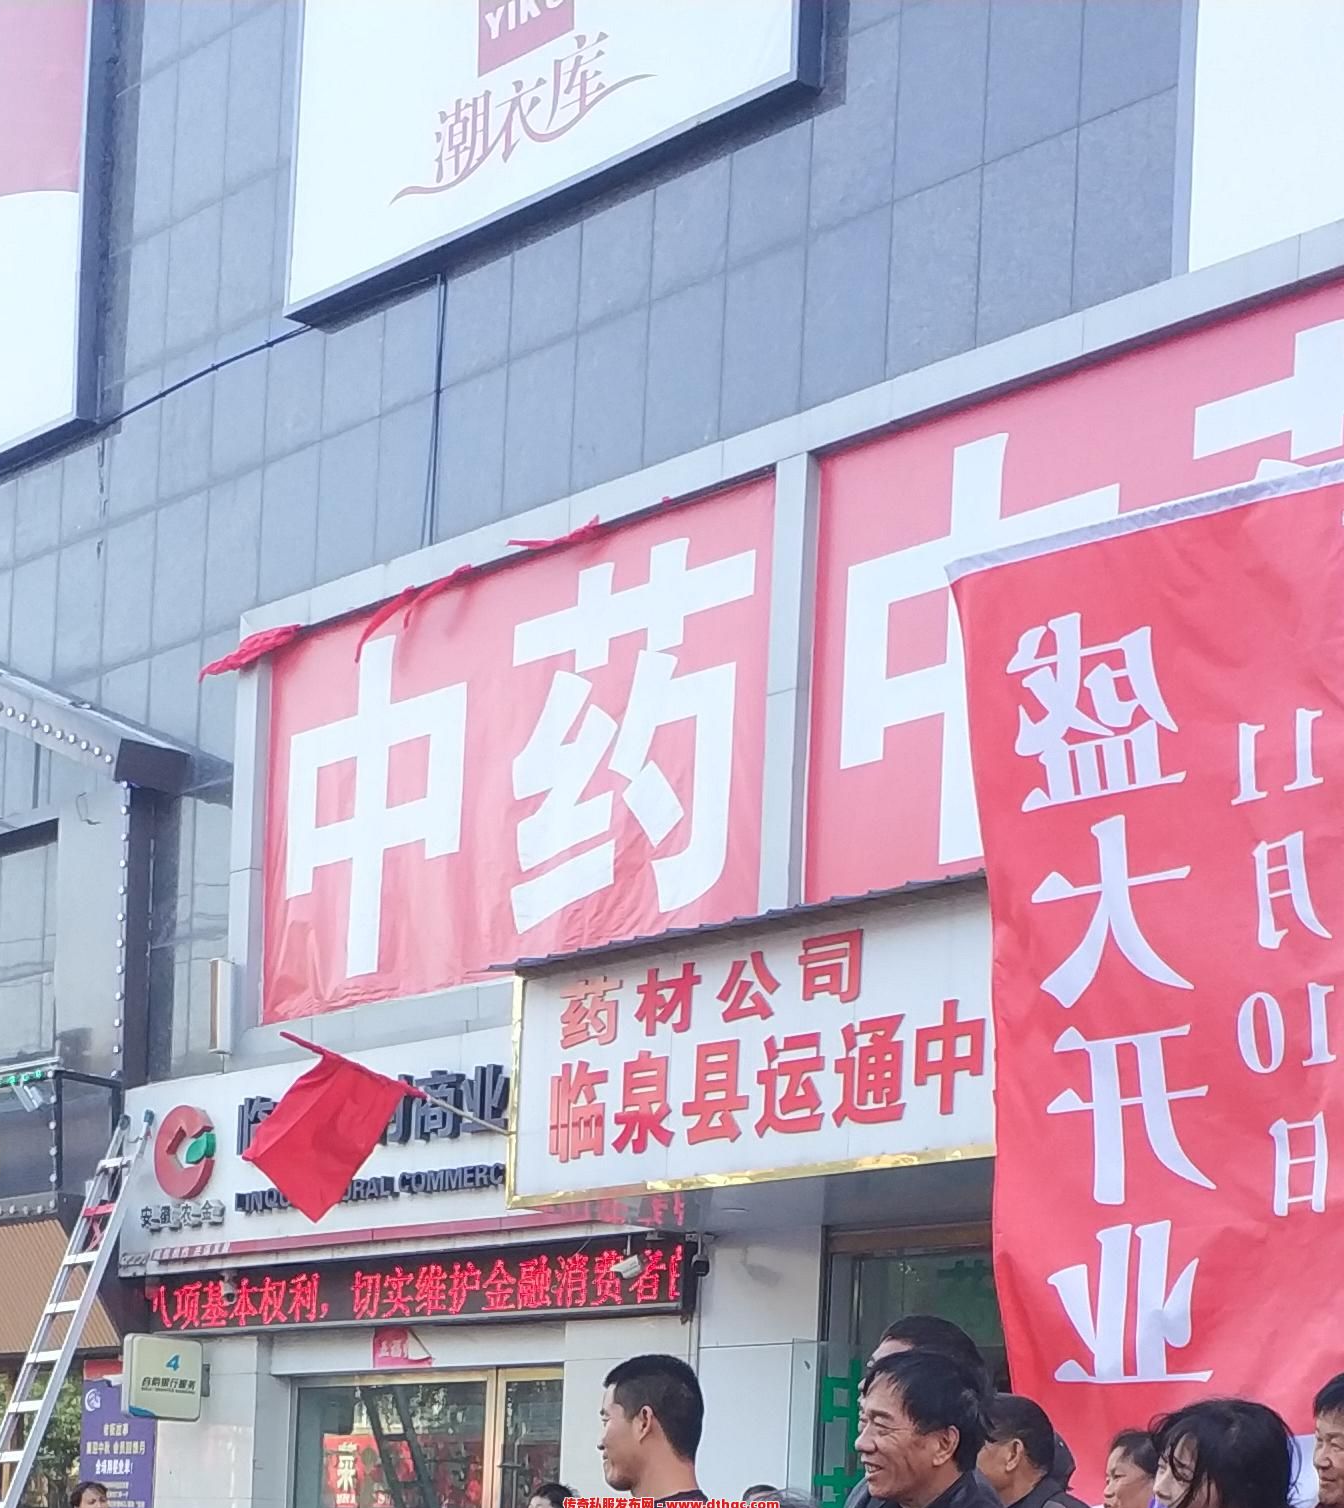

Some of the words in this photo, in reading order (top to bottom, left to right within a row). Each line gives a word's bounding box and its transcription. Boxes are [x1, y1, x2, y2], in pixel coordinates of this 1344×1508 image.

[432, 31, 610, 184] 潮衣库
[286, 537, 755, 978] 中药
[559, 929, 866, 1050] 药材公司
[548, 999, 988, 1164] 临泉县运通中
